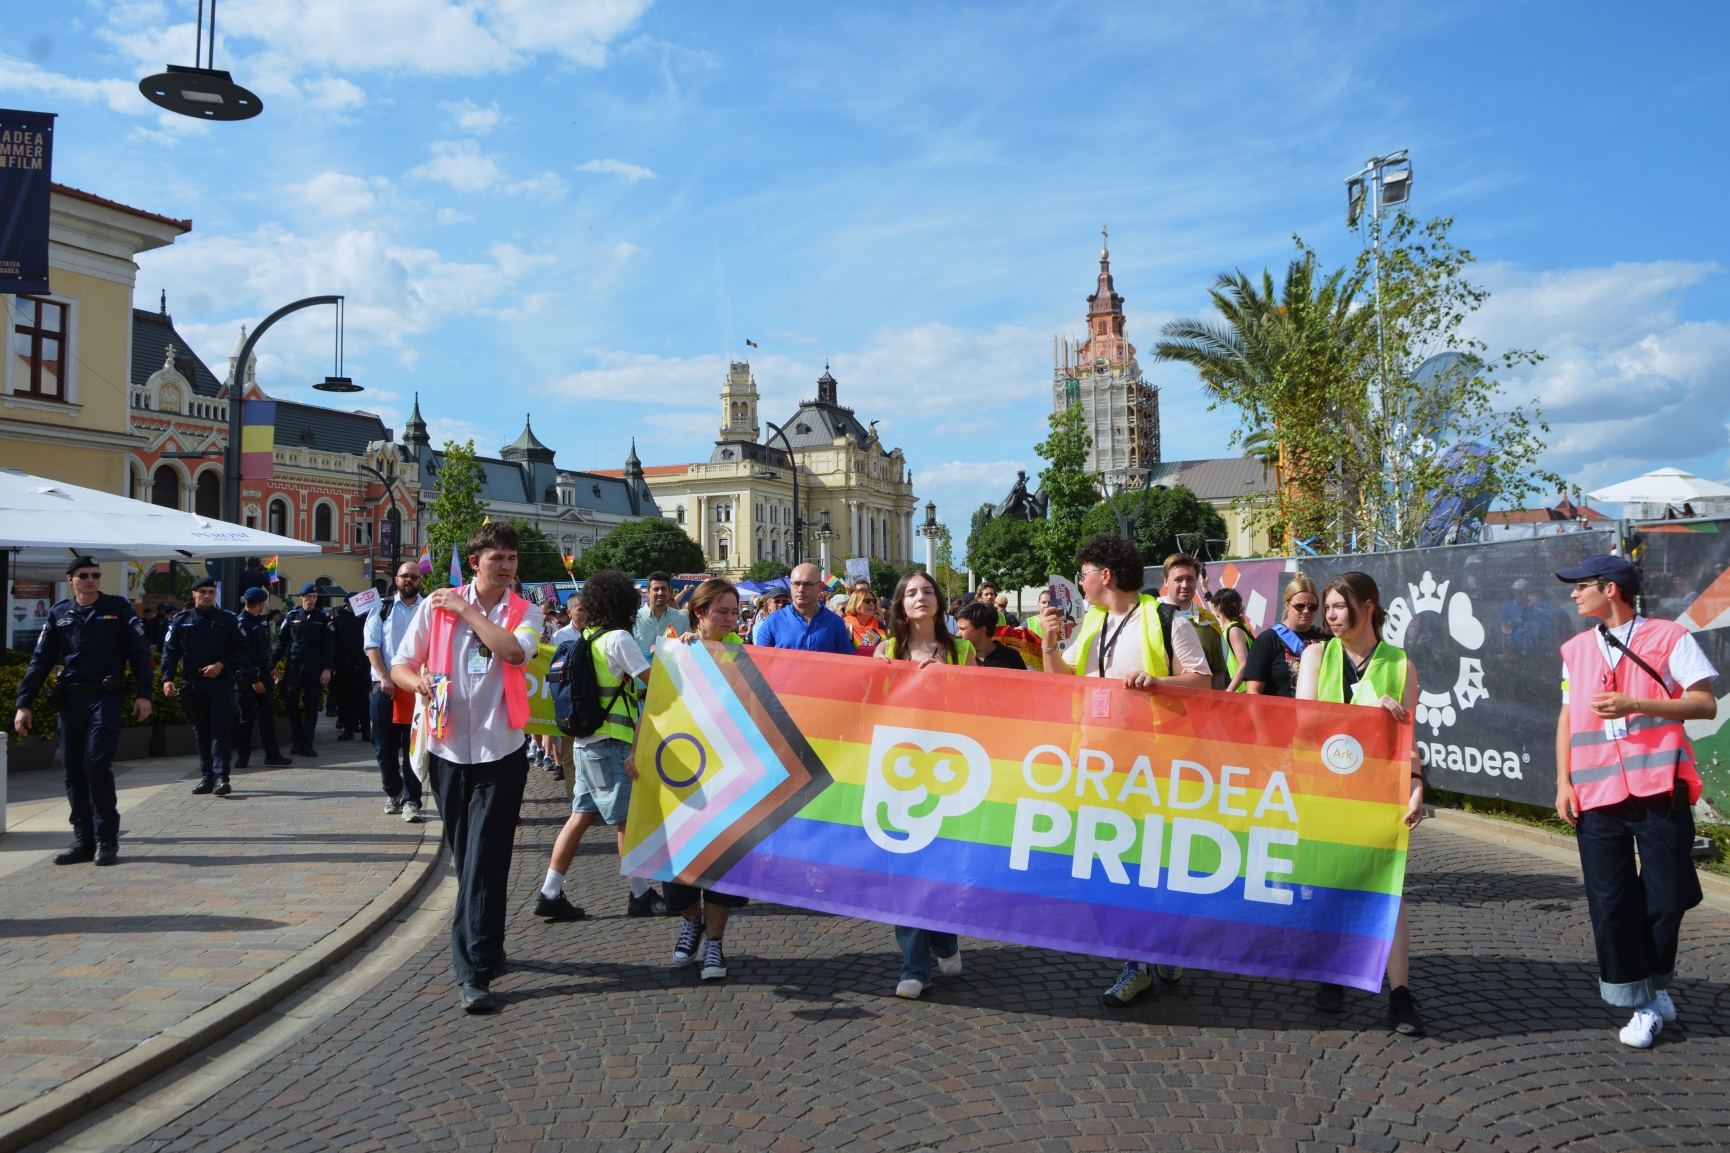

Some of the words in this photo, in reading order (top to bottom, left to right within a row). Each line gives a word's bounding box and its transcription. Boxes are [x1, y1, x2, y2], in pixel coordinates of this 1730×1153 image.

[9, 156, 42, 169] FILM
[1333, 748, 1352, 760] Ark
[1022, 744, 1298, 823] ORADEA
[1009, 797, 1298, 905] PRIDE
